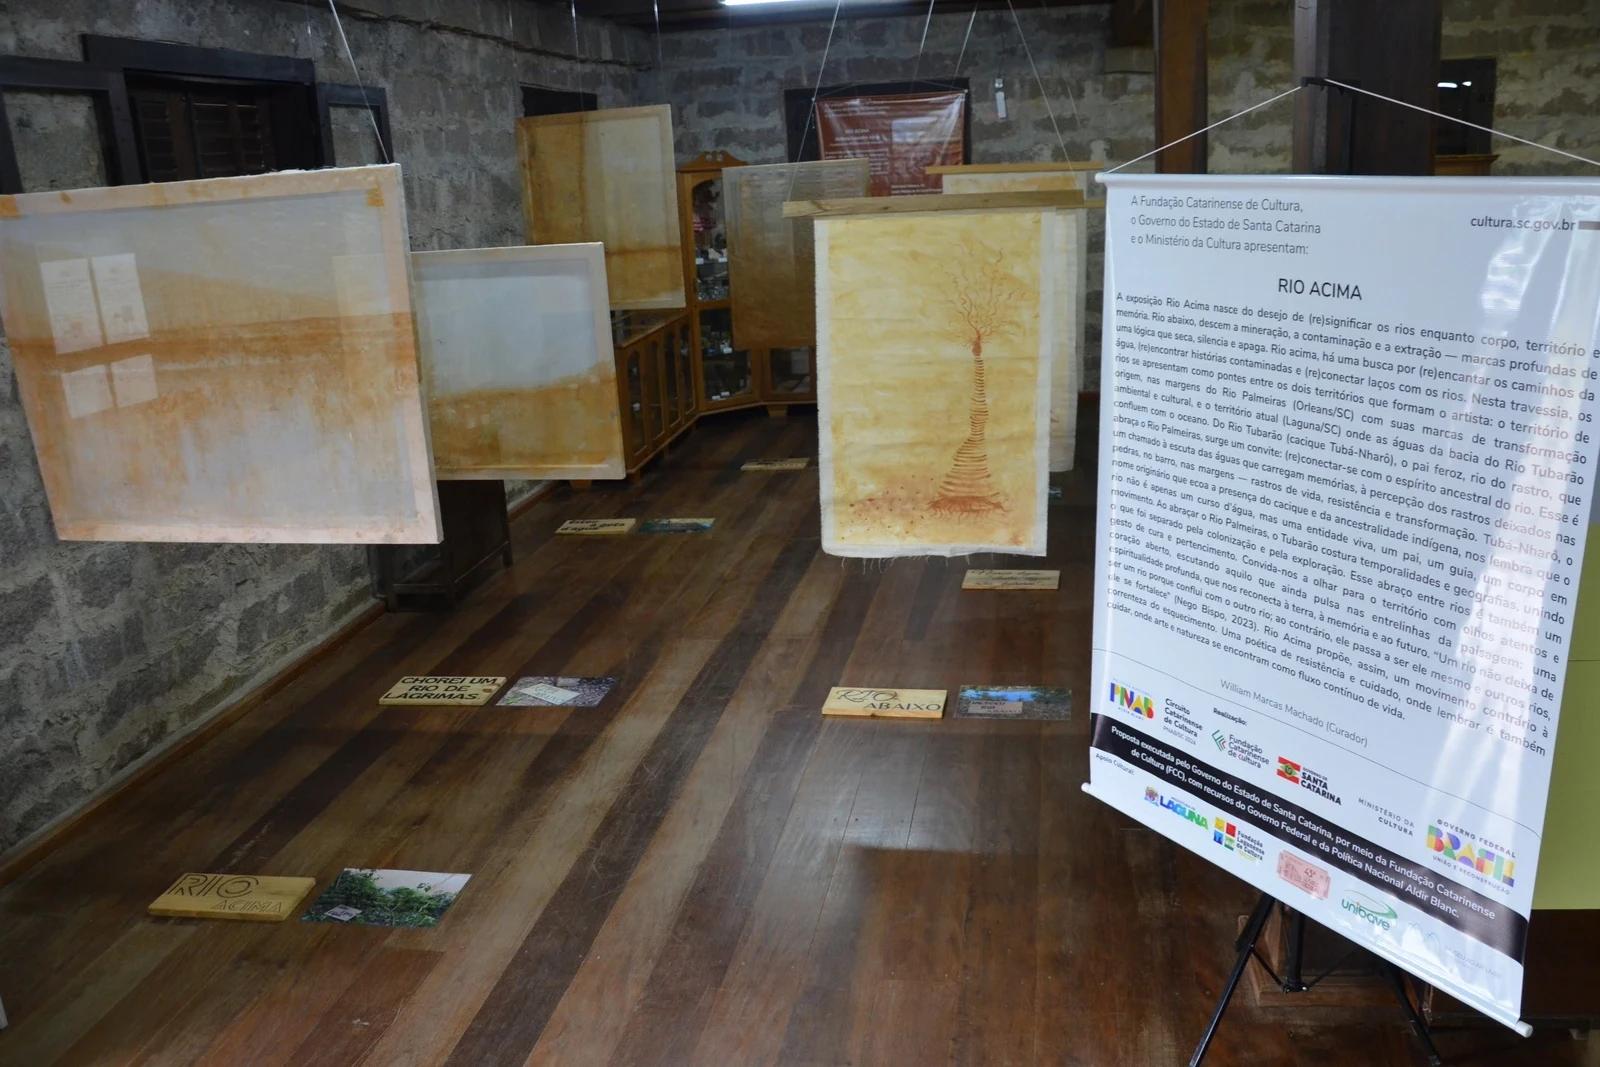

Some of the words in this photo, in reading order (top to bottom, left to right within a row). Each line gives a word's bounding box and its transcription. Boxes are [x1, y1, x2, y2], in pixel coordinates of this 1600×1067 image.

[1131, 196, 1138, 205] A
[1140, 196, 1183, 210] Fundação
[1186, 197, 1242, 210] Catarinense
[1246, 198, 1258, 210] de
[1262, 198, 1303, 212] Cultura,
[1139, 215, 1176, 227] Governo
[1180, 216, 1190, 227] do
[1193, 217, 1225, 229] Estado
[1228, 218, 1240, 229] de
[1243, 219, 1272, 231] Santa
[1276, 220, 1321, 234] Catarina
[1471, 216, 1576, 232] cultura.sc.gov.br
[1146, 235, 1189, 246] Ministério
[1193, 237, 1203, 247] da
[1206, 237, 1241, 250] Cultura
[1244, 242, 1308, 254] apresentam:
[1278, 278, 1304, 294] RIO
[1310, 281, 1362, 300] ACIMA
[1116, 291, 1122, 300] A
[1125, 295, 1162, 306] exposição
[1165, 297, 1179, 307] Rio
[1183, 298, 1209, 311] Acima
[1213, 305, 1237, 314] nasce
[1241, 305, 1253, 316] do
[1256, 307, 1287, 322] desejo
[1291, 311, 1304, 322] de
[1308, 312, 1372, 330] (re)significar
[1376, 323, 1389, 332] os
[1393, 323, 1415, 335] rios
[1419, 328, 1475, 342] enquanto
[1480, 335, 1519, 349] corpo,
[1524, 338, 1586, 355] território
[1591, 348, 1600, 357] e
[1146, 376, 1160, 384] nas
[1164, 379, 1200, 392] margens
[1204, 384, 1216, 395] do
[1221, 387, 1236, 398] Rio
[1241, 390, 1286, 408] Palmeiras
[1291, 399, 1354, 423] (Orleans/SC)
[1359, 414, 1383, 426] com
[1389, 420, 1415, 432] suas
[1421, 426, 1464, 441] marcas
[1471, 431, 1485, 444] de
[1492, 436, 1586, 463] transformação
[1145, 541, 1170, 557] aberto,
[1176, 552, 1219, 571] escutando
[1225, 568, 1251, 582] aquilo
[1258, 578, 1274, 589] que
[1281, 584, 1306, 600] ainda
[1313, 596, 1339, 610] pulsa
[1346, 606, 1364, 618] nas
[1371, 614, 1430, 640] entrelinhas
[1438, 633, 1452, 647] da
[1532, 666, 1556, 681] uma
[1133, 610, 1152, 622] onde
[1153, 618, 1168, 629] arte
[1176, 626, 1210, 645] natureza
[1211, 640, 1221, 649] se
[1223, 644, 1269, 668] encontram
[1271, 662, 1295, 678] como
[1297, 670, 1321, 688] fluxo
[1323, 682, 1364, 704] contínuo
[1366, 696, 1379, 710] de
[1381, 704, 1404, 720] vida.
[836, 689, 898, 702] RIO
[864, 702, 941, 711] ABAIXO
[1110, 682, 1153, 719] PNAB
[1165, 698, 1190, 715] Circuito
[1165, 708, 1202, 730] Catarinense
[1213, 707, 1247, 726] Realização:
[1221, 680, 1250, 698] William
[1254, 692, 1282, 710] Marcas
[1285, 704, 1323, 727] Machado
[1327, 721, 1368, 747] (Curador)
[1175, 720, 1197, 737] Cultura
[1228, 742, 1269, 764] Catarinense
[1229, 734, 1262, 753] Fundação
[1238, 754, 1261, 768] cultura
[1302, 772, 1328, 790] SANTA
[1301, 780, 1341, 805] CATARINA
[1112, 726, 1139, 746] Proposta
[1141, 742, 1174, 763] executada
[1176, 758, 1190, 770] pelo
[1192, 765, 1220, 786] Governo
[1222, 780, 1232, 791] do
[1234, 785, 1260, 805] Estado
[1261, 798, 1271, 810] de
[1274, 802, 1296, 821] Santa
[1298, 815, 1334, 841] Catarina,
[1336, 836, 1350, 849] por
[1352, 844, 1373, 860] meio
[1375, 854, 1387, 866] da
[1389, 860, 1434, 890] Fundação
[1437, 884, 1495, 920] Catarinense
[1160, 796, 1209, 831] LAGUNA
[1358, 798, 1400, 823] MINISTÉRIO
[1404, 818, 1415, 827] DA
[1131, 749, 1140, 758] de
[1141, 753, 1164, 771] Cultura
[1166, 766, 1186, 782] (FCC),
[1188, 778, 1202, 790] com
[1204, 785, 1233, 806] recursos
[1236, 800, 1245, 811] do
[1247, 805, 1279, 827] Governo
[1281, 822, 1310, 842] Federal
[1319, 841, 1329, 852] da
[1332, 846, 1362, 869] Política
[1365, 864, 1403, 889] Nacional
[1405, 884, 1429, 903] Aldir
[1431, 896, 1459, 918] Blanc.
[1378, 817, 1413, 836] CULTURA
[1237, 838, 1265, 855] Lagunense
[1238, 831, 1263, 848] Fundação
[1437, 819, 1475, 840] GOVERNO
[1479, 837, 1516, 858] FEDERAL
[1244, 847, 1263, 861] Cultura
[1427, 824, 1514, 887] BRASIL
[167, 874, 260, 898] RIO
[214, 900, 283, 913] ACIMA
[1341, 899, 1390, 930] unibave
